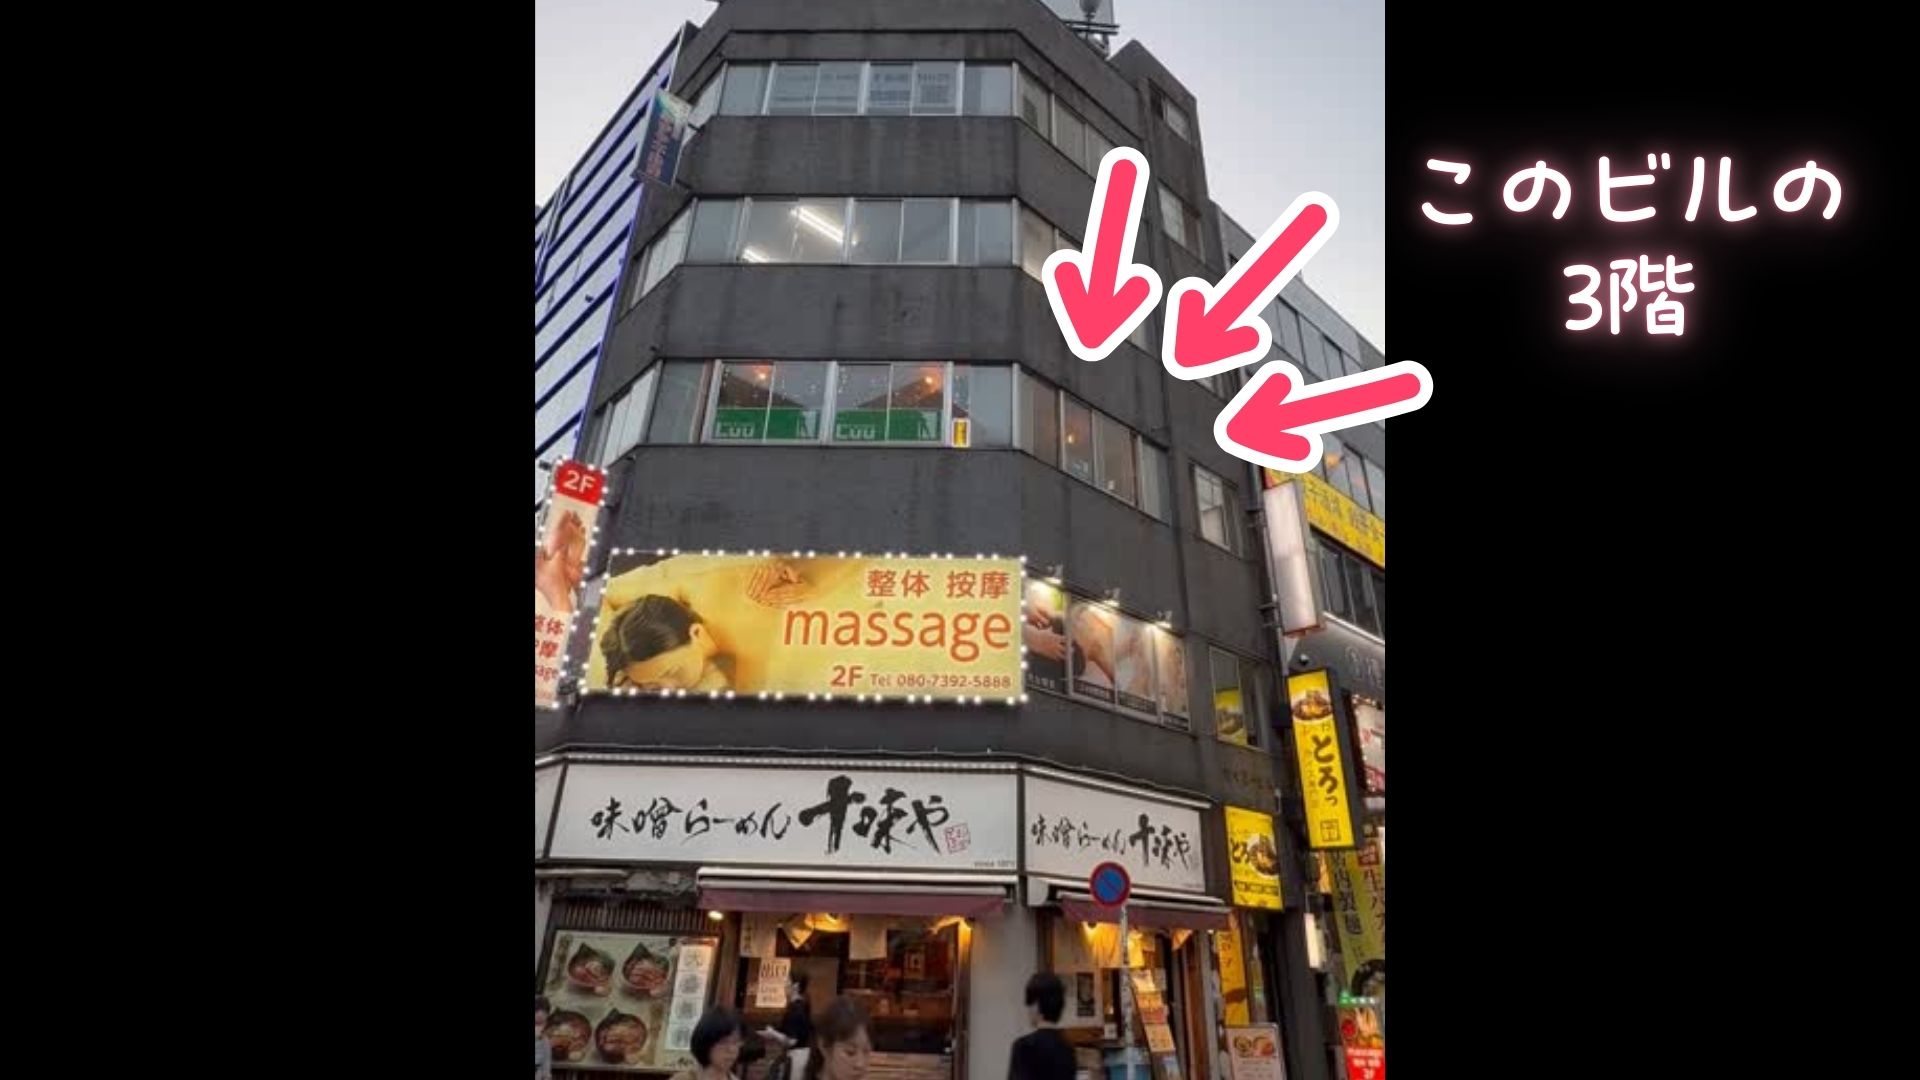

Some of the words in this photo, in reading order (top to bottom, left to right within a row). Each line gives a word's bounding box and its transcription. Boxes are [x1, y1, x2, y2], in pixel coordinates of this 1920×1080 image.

[563, 470, 596, 493] 2F
[866, 569, 931, 598] 整体
[946, 570, 1011, 599] 按摩
[783, 609, 1012, 663] massage
[830, 665, 863, 687] 2F
[896, 674, 1012, 688] 080-7392-5888
